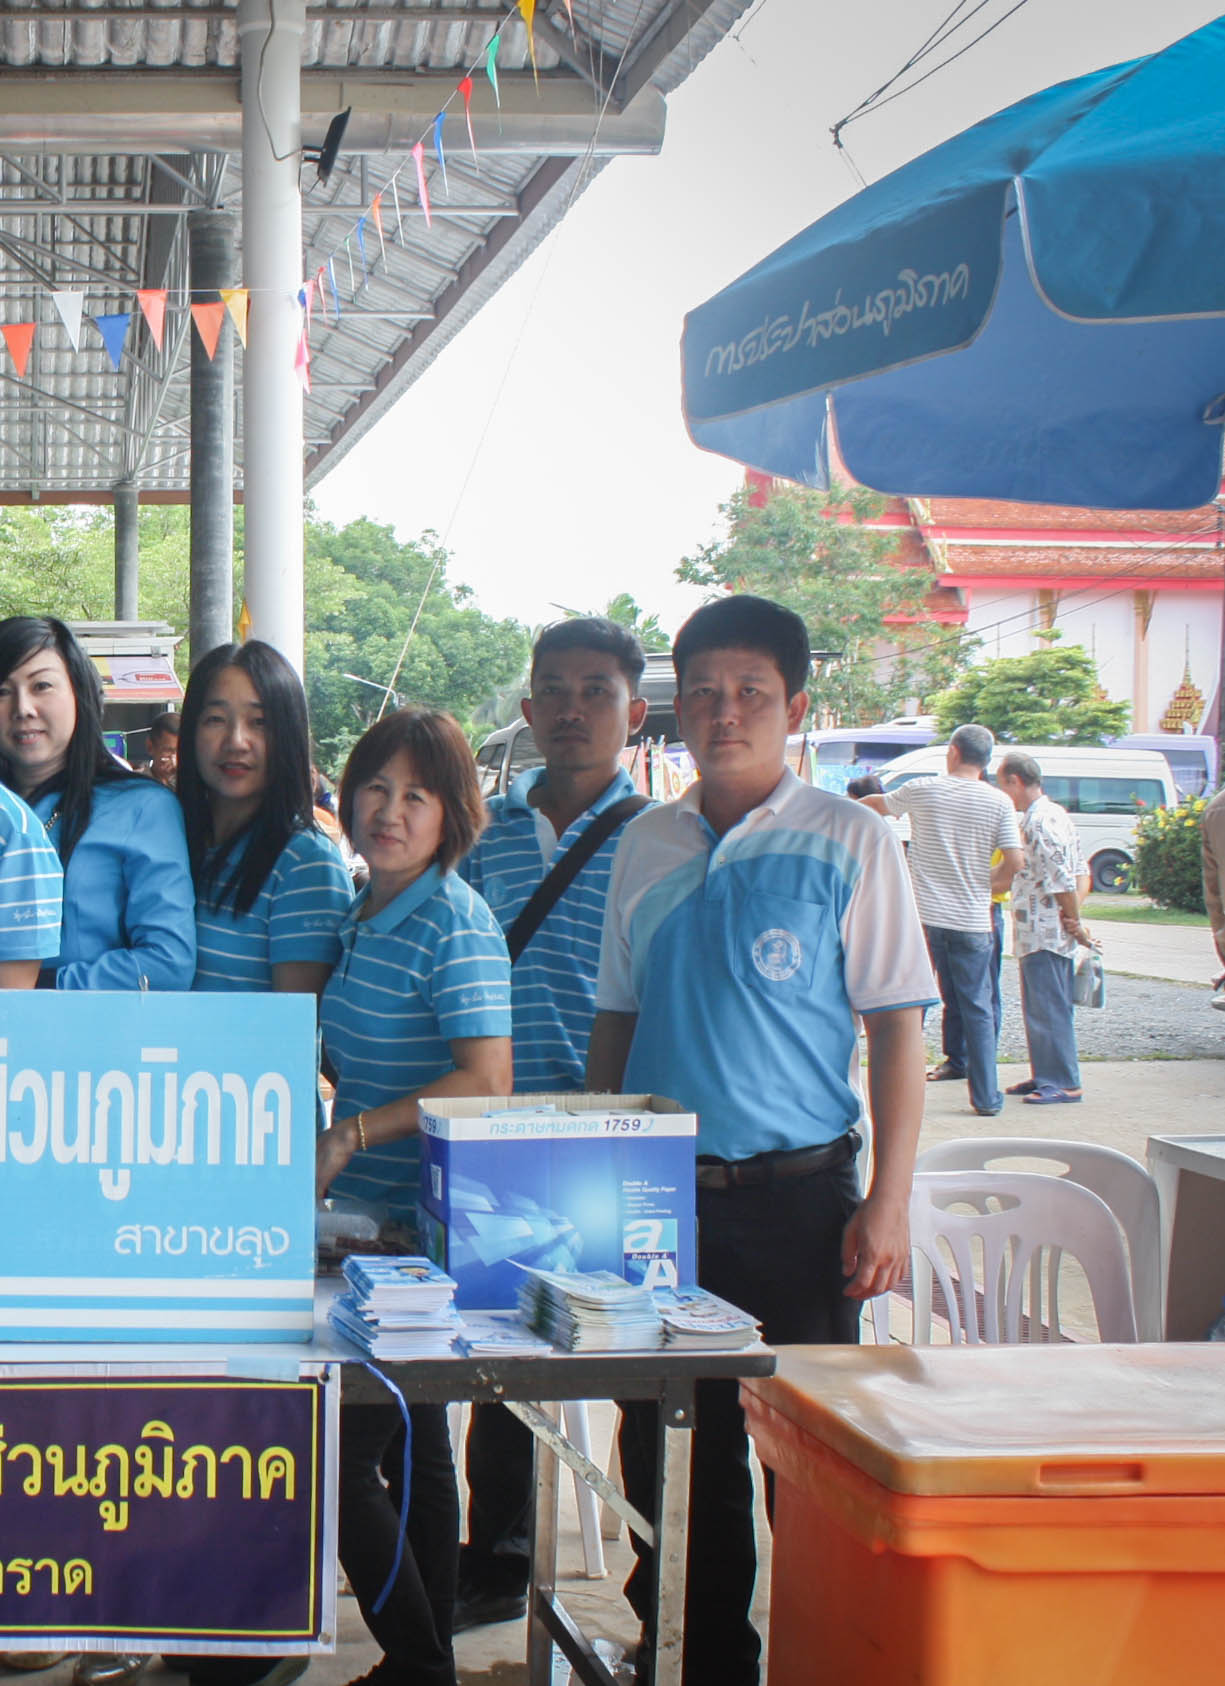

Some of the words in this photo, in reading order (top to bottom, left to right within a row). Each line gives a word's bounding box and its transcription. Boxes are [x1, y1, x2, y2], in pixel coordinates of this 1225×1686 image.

[705, 264, 969, 377] การประปาส่วนภูมิภาค
[603, 1118, 642, 1132] 1759
[114, 1224, 291, 1268] สาขาขลุง
